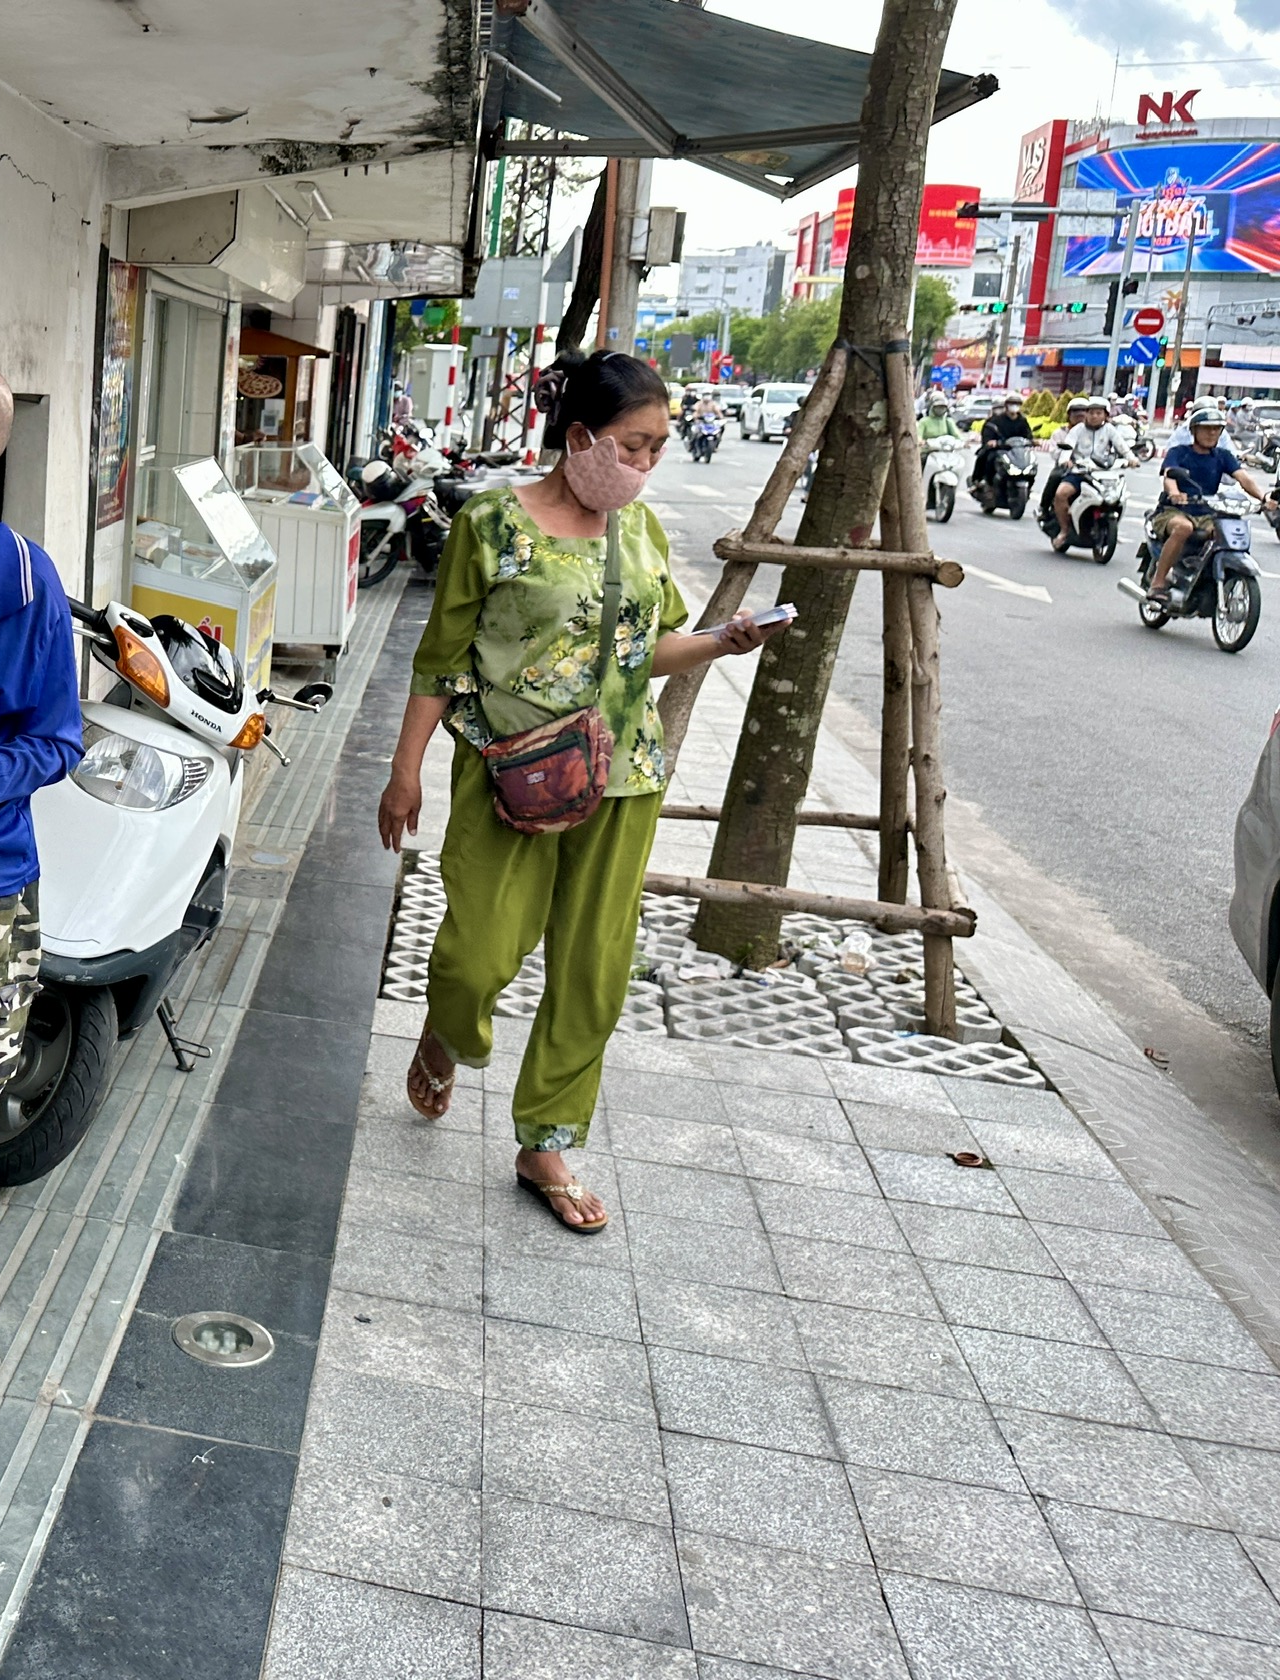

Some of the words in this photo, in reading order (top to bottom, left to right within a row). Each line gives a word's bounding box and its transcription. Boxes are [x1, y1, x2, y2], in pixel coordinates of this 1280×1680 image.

[1137, 88, 1202, 126] NK
[1119, 208, 1219, 239] FOTBALL
[191, 708, 223, 734] HONDA
